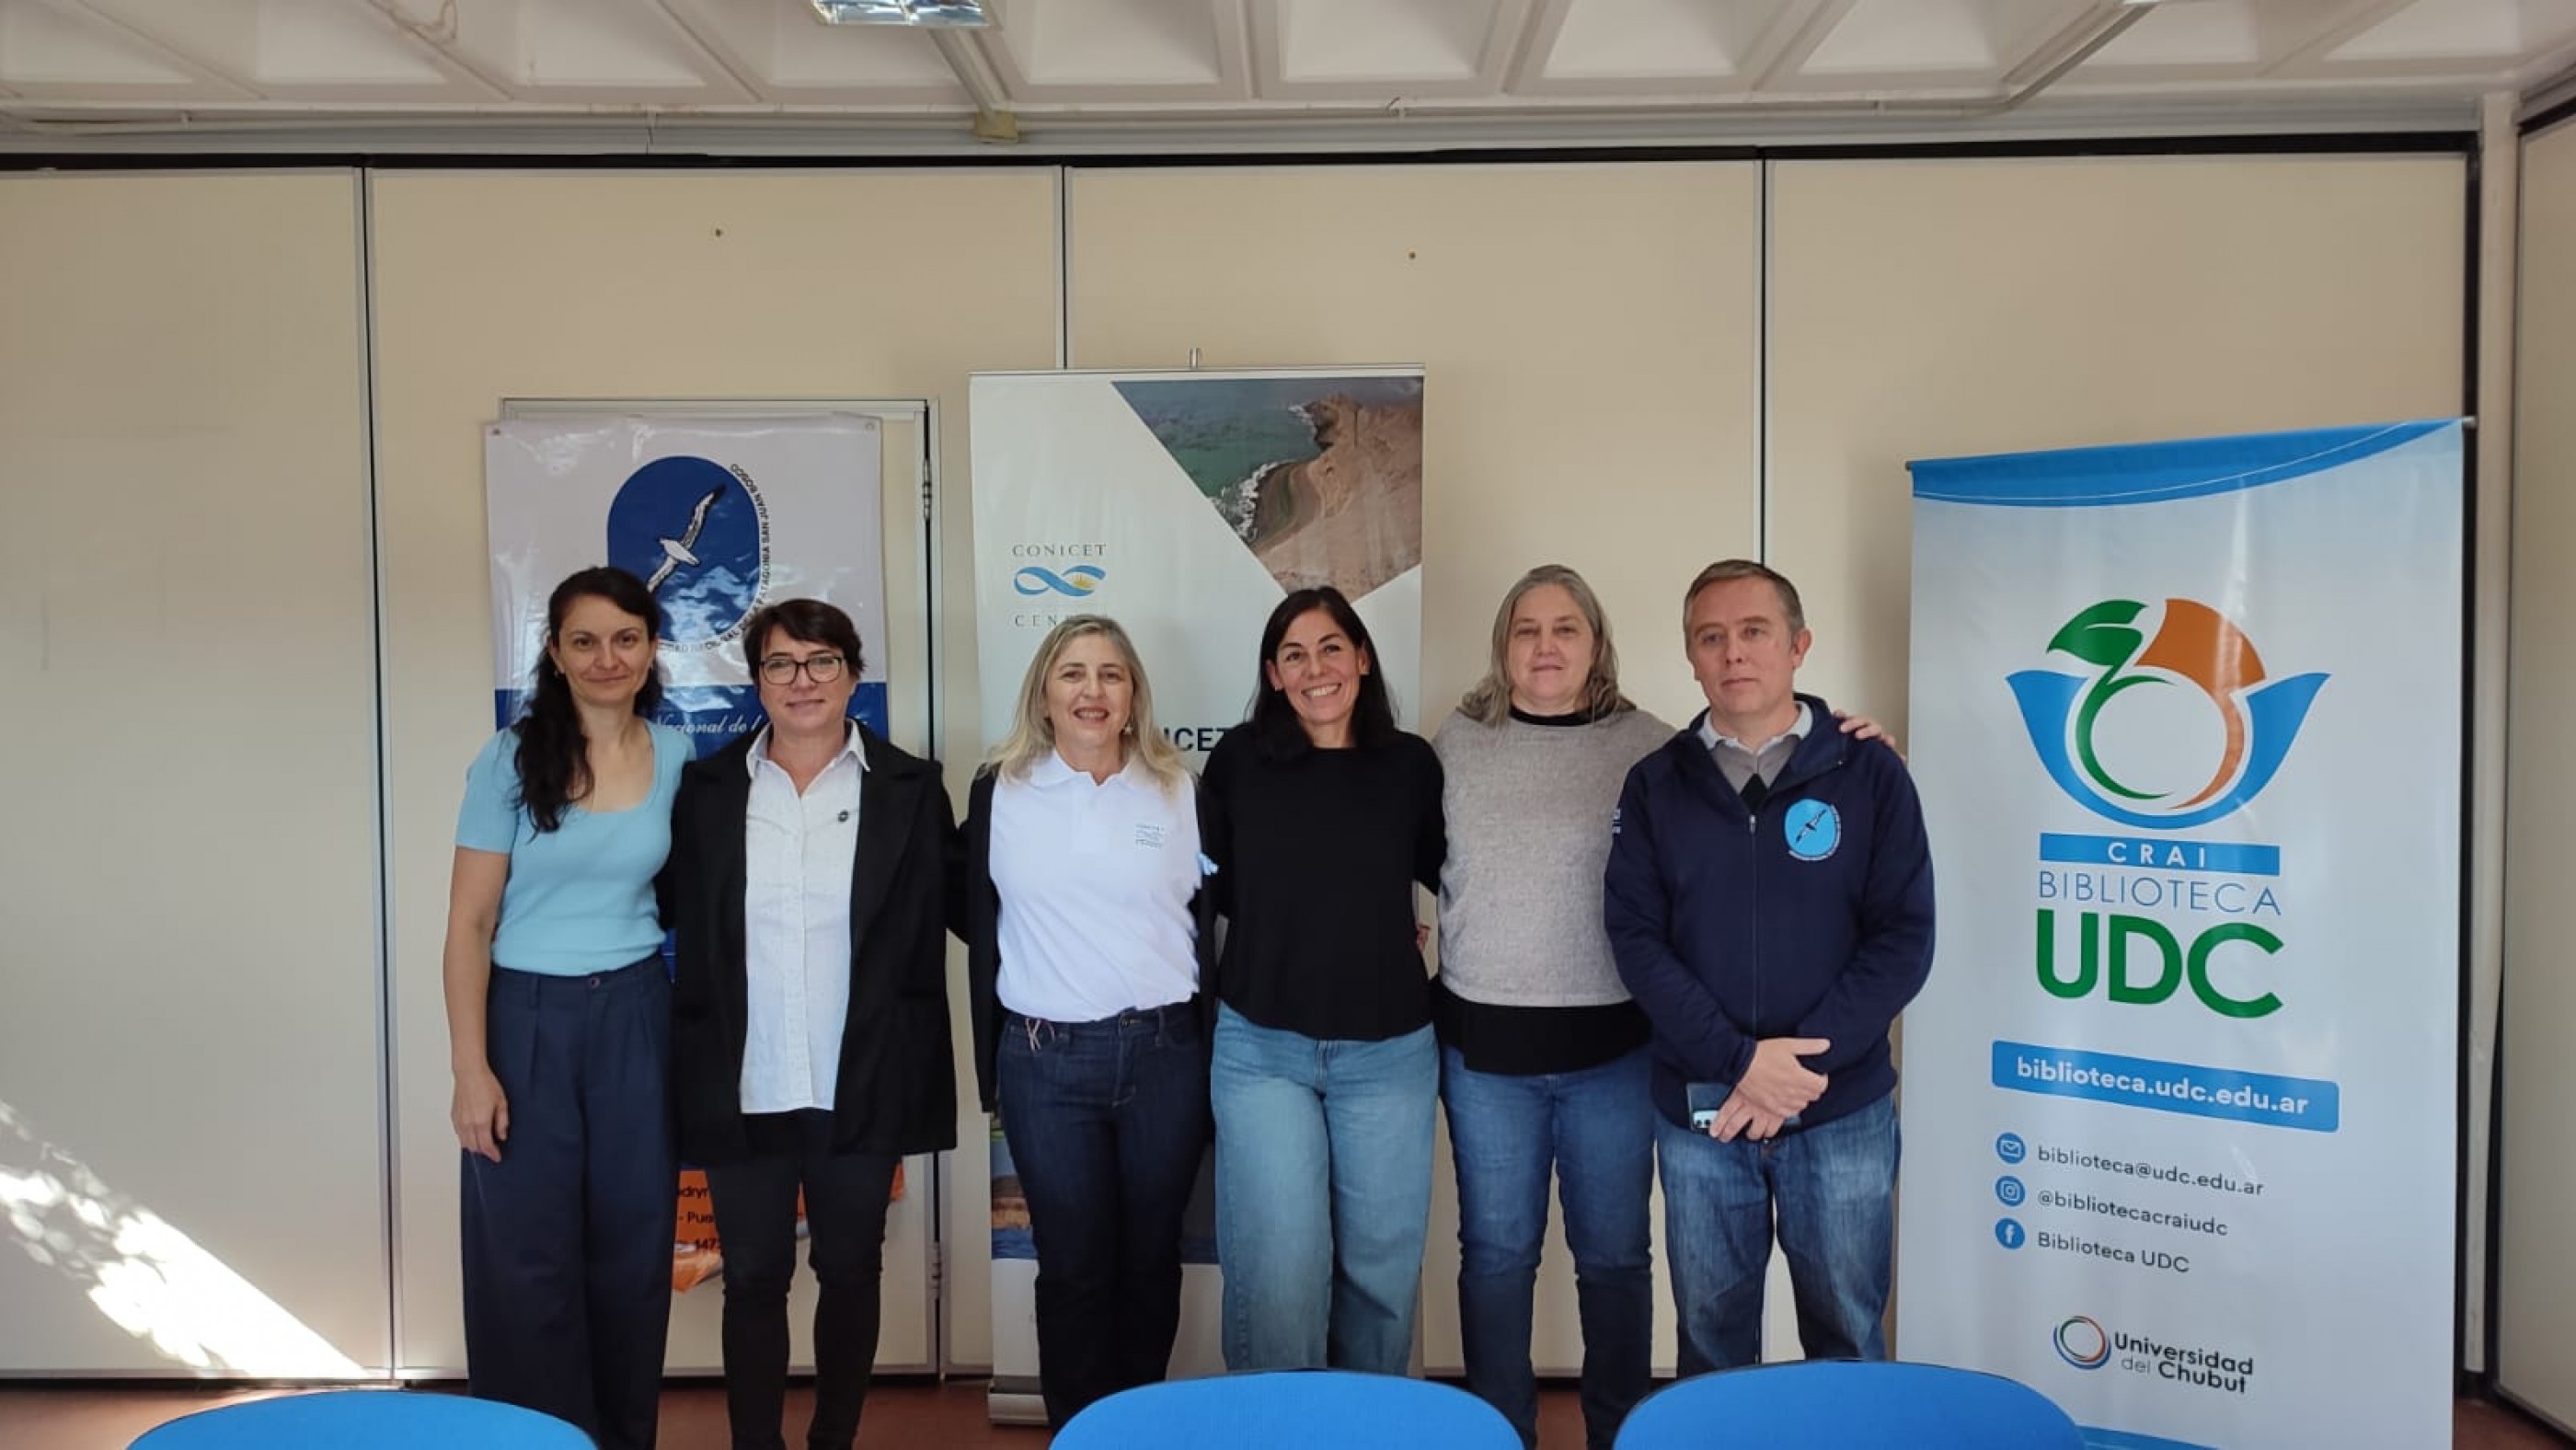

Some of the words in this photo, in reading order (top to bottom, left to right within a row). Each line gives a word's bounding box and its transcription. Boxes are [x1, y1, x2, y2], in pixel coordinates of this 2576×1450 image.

[1013, 544, 1107, 557] CONICET
[2108, 842, 2205, 869] CRAI
[2039, 870, 2282, 916] BIBLIOTECA
[2036, 908, 2284, 1019] UDC
[2017, 1056, 2308, 1114] biblioteca.udc.edu.ar
[2038, 1145, 2264, 1196] biblioteca@udc.edu.ar
[2038, 1190, 2228, 1237] @bibliotecacraiudc
[2038, 1231, 2135, 1263] Biblioteca
[2141, 1249, 2190, 1273] UDC
[2115, 1332, 2253, 1375] Universidad
[2121, 1356, 2151, 1374] del
[2158, 1360, 2246, 1394] Chubut
